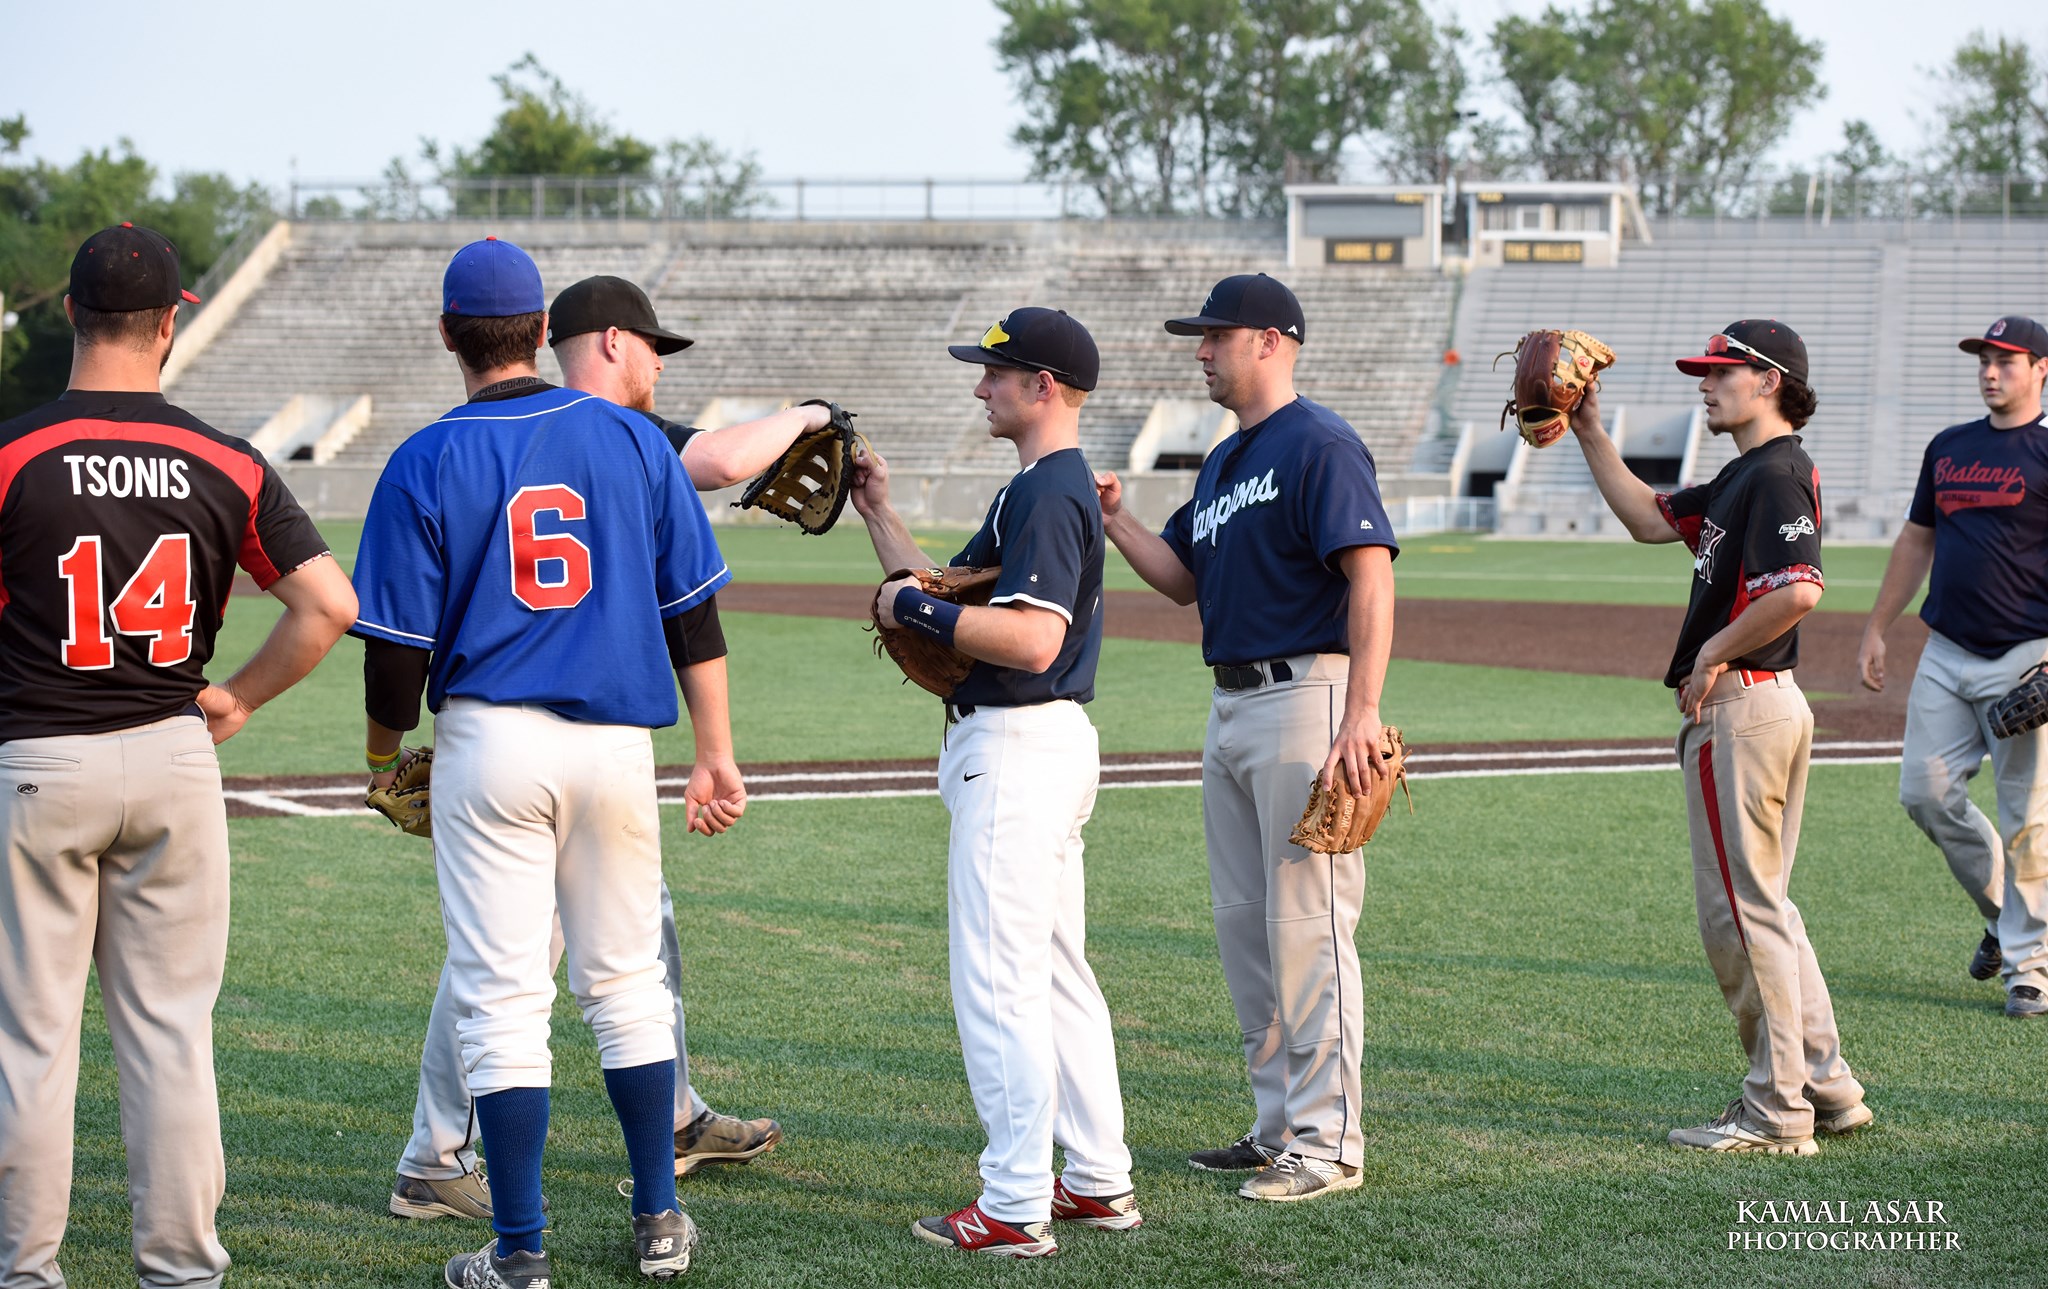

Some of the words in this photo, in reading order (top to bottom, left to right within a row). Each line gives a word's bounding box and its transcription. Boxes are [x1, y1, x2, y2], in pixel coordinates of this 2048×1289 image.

[479, 385, 498, 396] PRO
[500, 378, 538, 390] COMBAT
[64, 455, 191, 499] TSONIS
[1934, 457, 2022, 492] Bistany
[506, 483, 592, 611] 6
[58, 533, 196, 671] 14
[1340, 799, 1353, 829] WORTH
